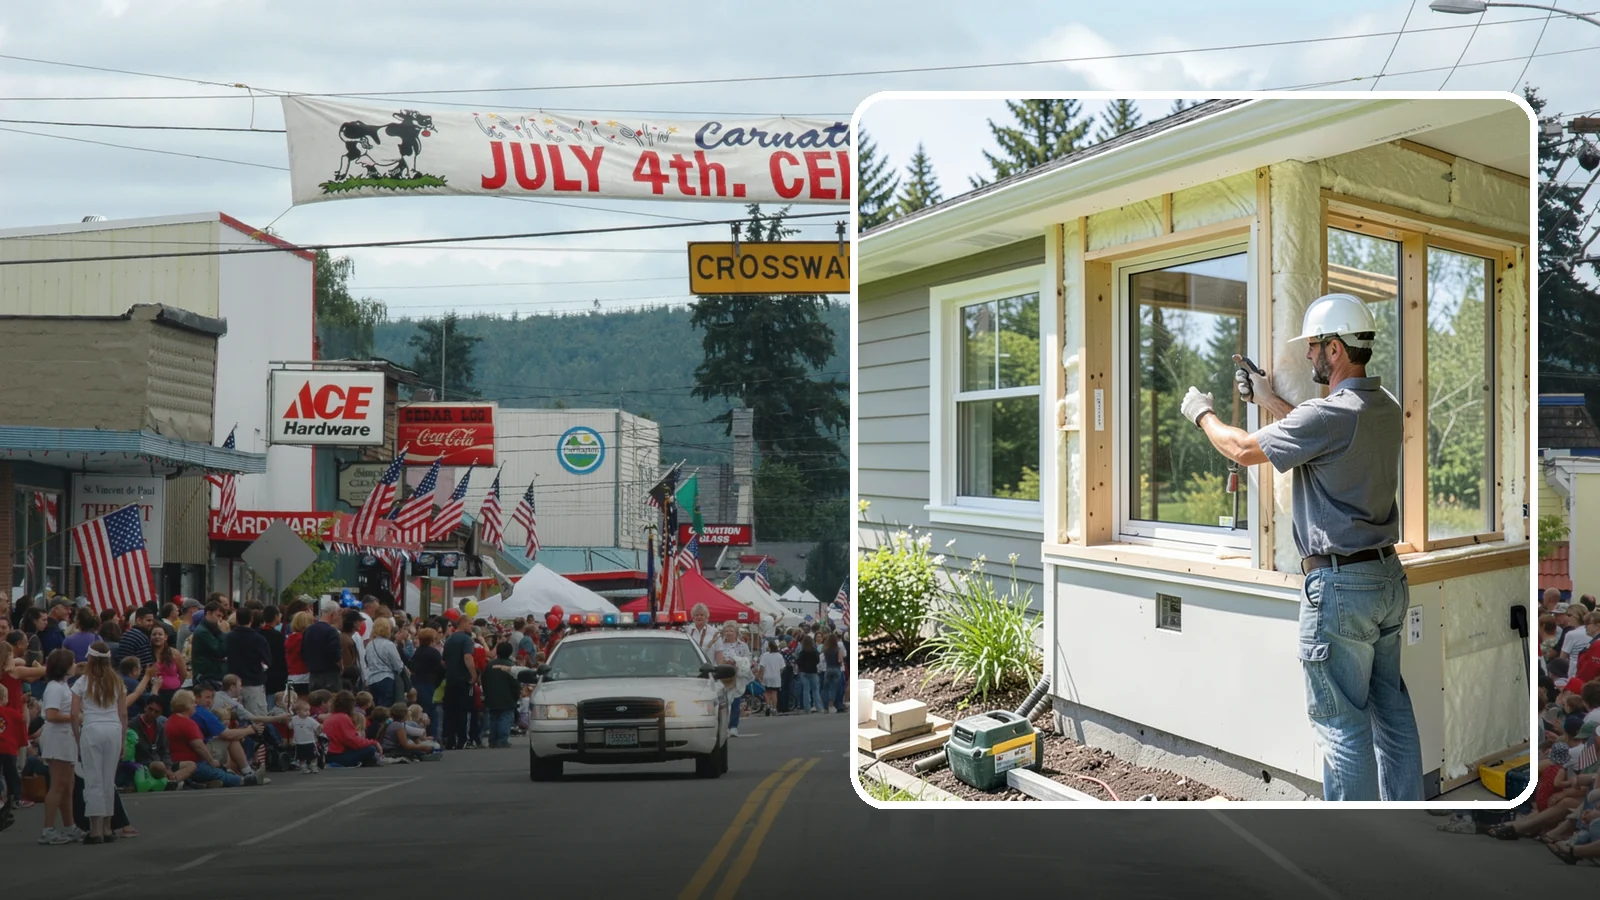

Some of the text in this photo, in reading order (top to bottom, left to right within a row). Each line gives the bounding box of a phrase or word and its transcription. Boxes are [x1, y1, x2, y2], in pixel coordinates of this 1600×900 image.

[695, 121, 850, 149] Carnat
[481, 141, 604, 192] JULY
[632, 150, 746, 198] 4th.
[697, 254, 850, 280] CROSSWA
[283, 380, 373, 420] ACE
[405, 409, 485, 422] CEDAR LOG
[283, 421, 371, 437] Hardware
[416, 428, 477, 447] Coca-Cola
[353, 467, 386, 480] Simpl
[95, 485, 124, 495] Vincent
[126, 486, 135, 495] de
[137, 486, 155, 495] Paul
[688, 526, 741, 535] CRNATION
[699, 535, 730, 543] GLASS
